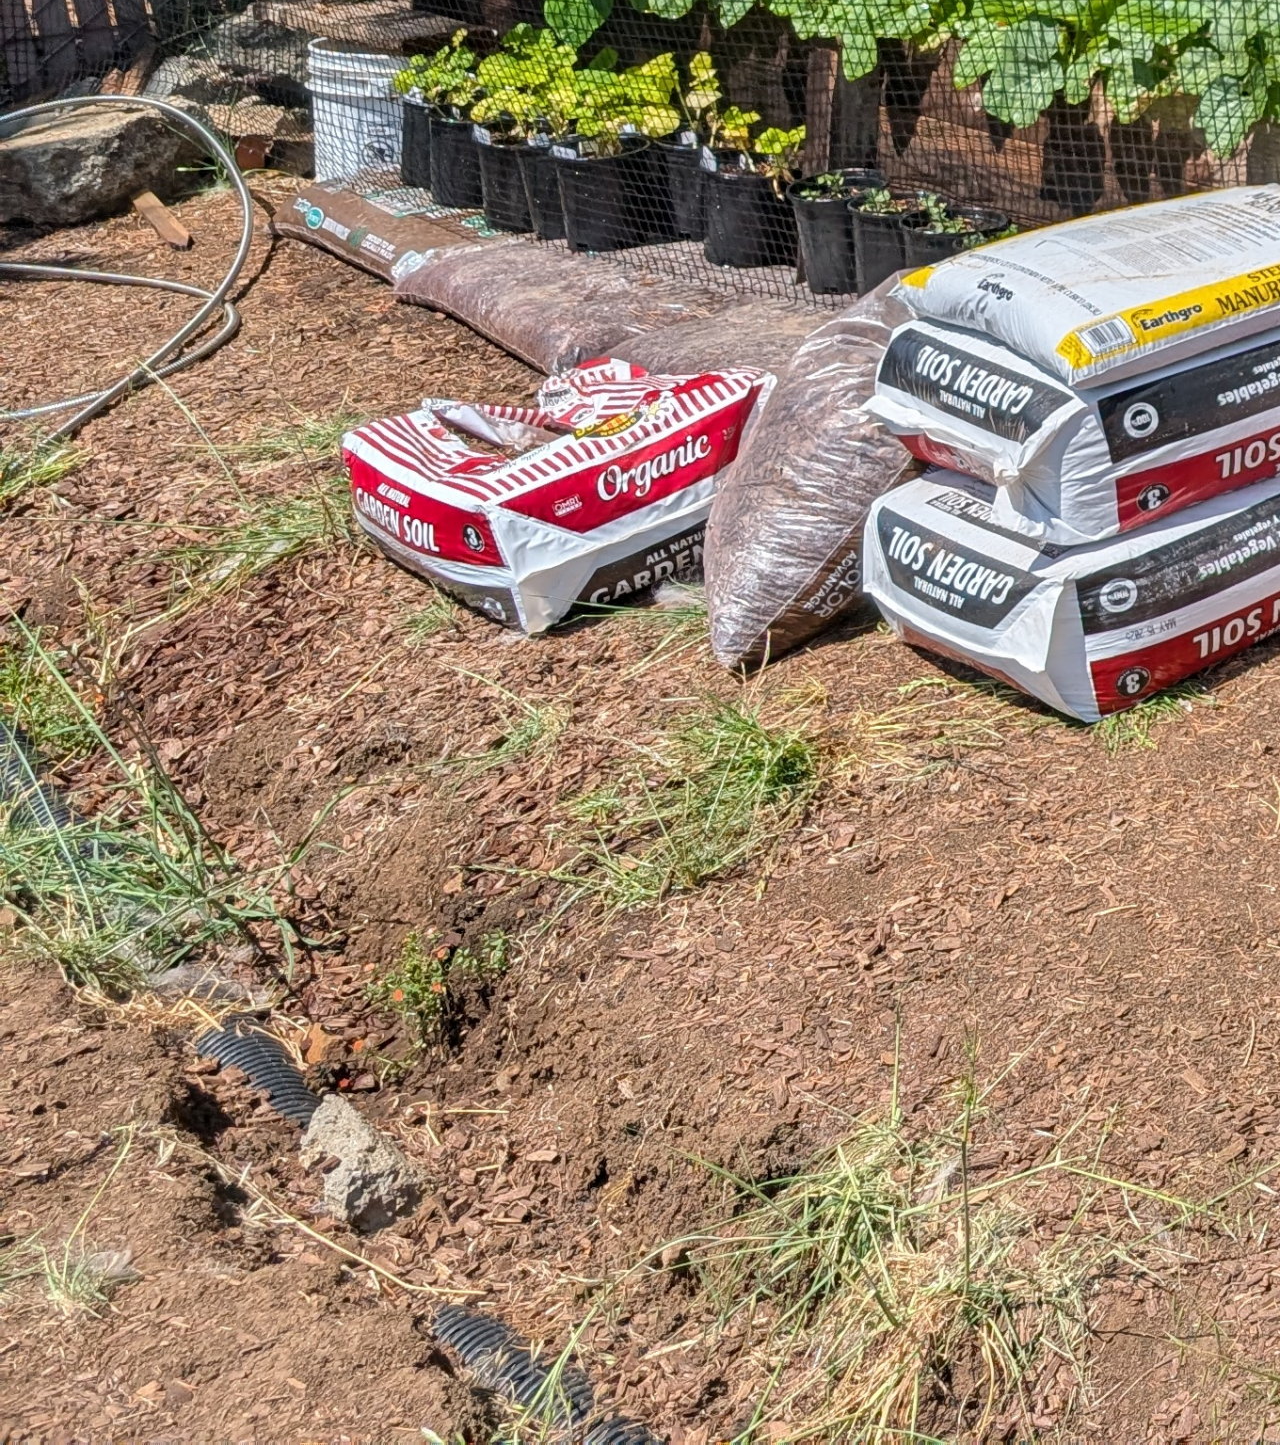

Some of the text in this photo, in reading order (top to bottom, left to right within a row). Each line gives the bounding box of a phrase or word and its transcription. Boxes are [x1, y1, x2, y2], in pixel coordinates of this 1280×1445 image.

[977, 277, 1014, 302] Earthgro
[1140, 304, 1203, 331] Earthgro
[916, 345, 1034, 414] GARDEN SOIL
[939, 389, 986, 419] ALL NATURAL
[597, 435, 712, 501] Organic
[938, 491, 970, 509] SOIL
[1147, 489, 1162, 510] 3
[356, 488, 440, 553] GARDEN SOIL
[466, 528, 479, 546] 3
[646, 528, 706, 566] ALL NATU
[1198, 536, 1277, 581] Vegetables
[803, 550, 857, 612] ADVANTAGE
[888, 526, 1015, 604] GARDEN SOIL
[913, 575, 966, 609] ALL NATURAL
[1158, 617, 1177, 634] MAY
[1192, 608, 1264, 659] SOIL
[1126, 673, 1140, 694] 3
